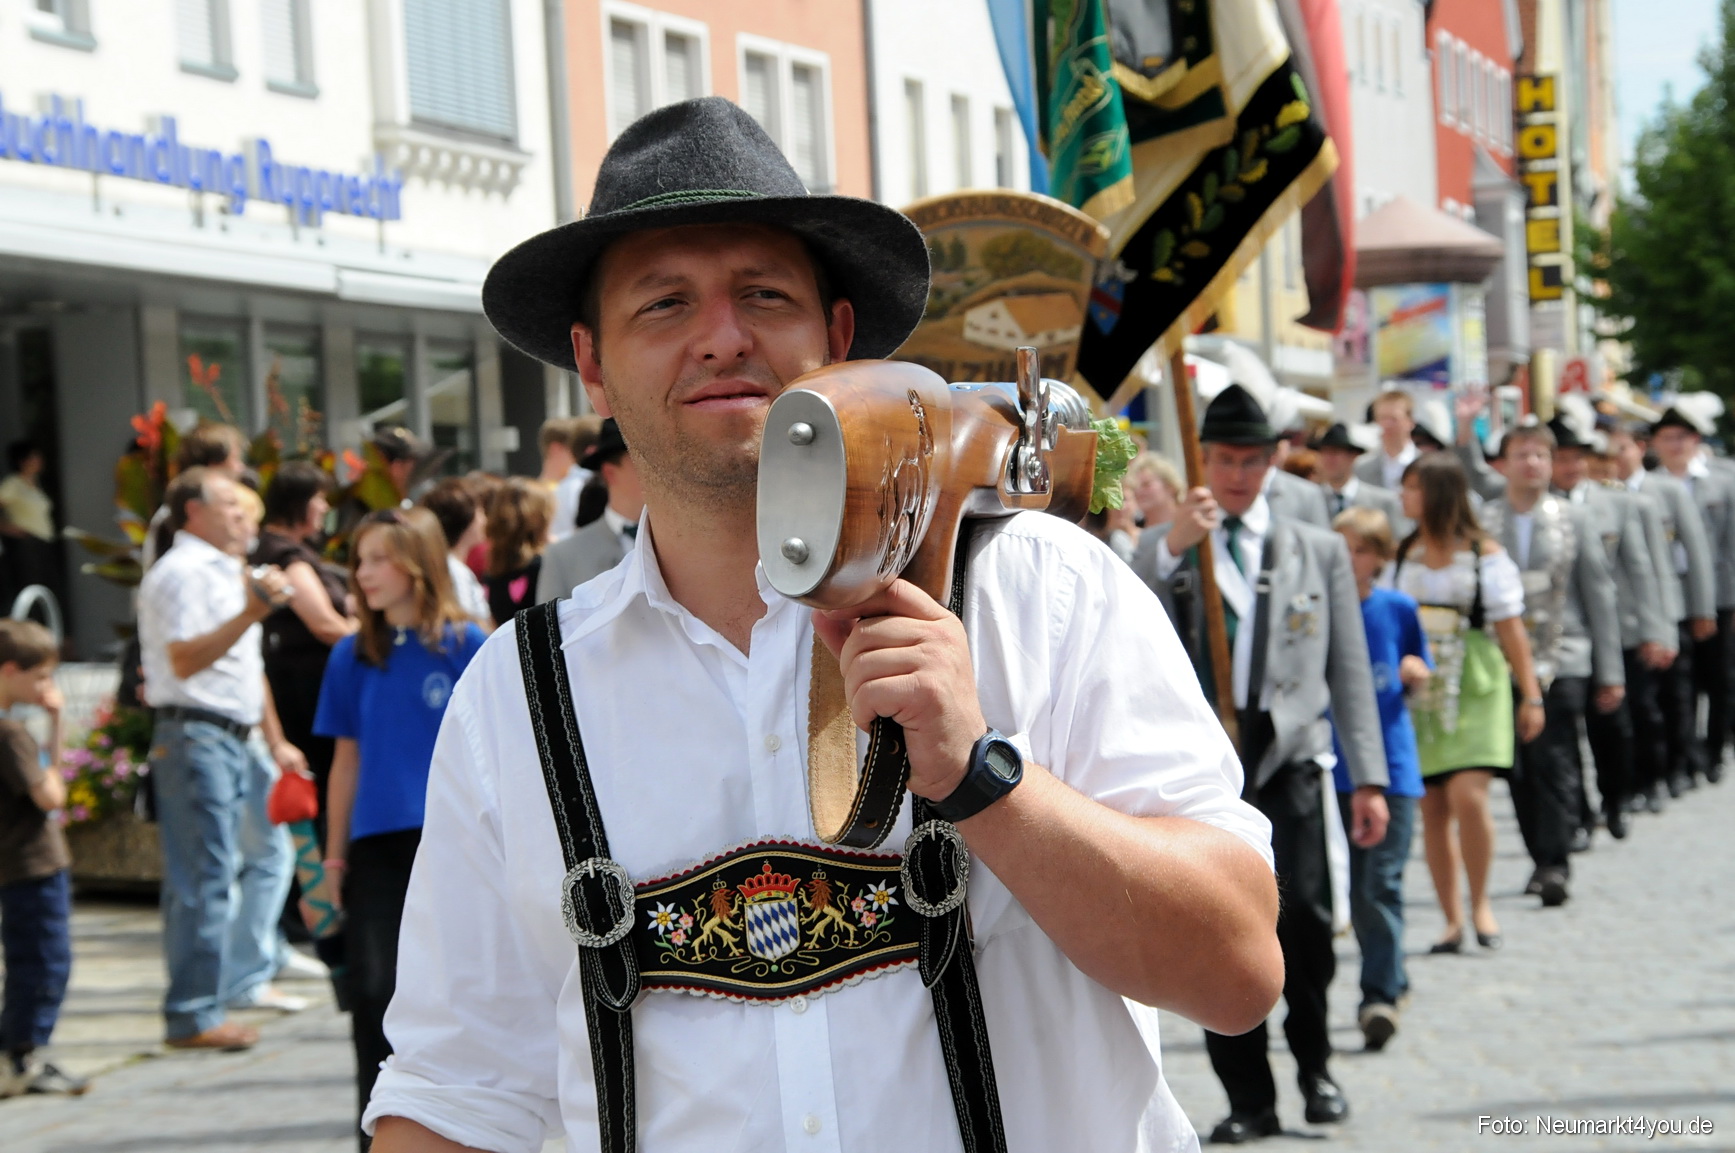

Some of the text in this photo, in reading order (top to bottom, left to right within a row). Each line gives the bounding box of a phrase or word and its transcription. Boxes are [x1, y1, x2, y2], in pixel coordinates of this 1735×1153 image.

[0, 91, 402, 227] uchhandlung Rupprecht
[1517, 76, 1562, 299] HOTEL
